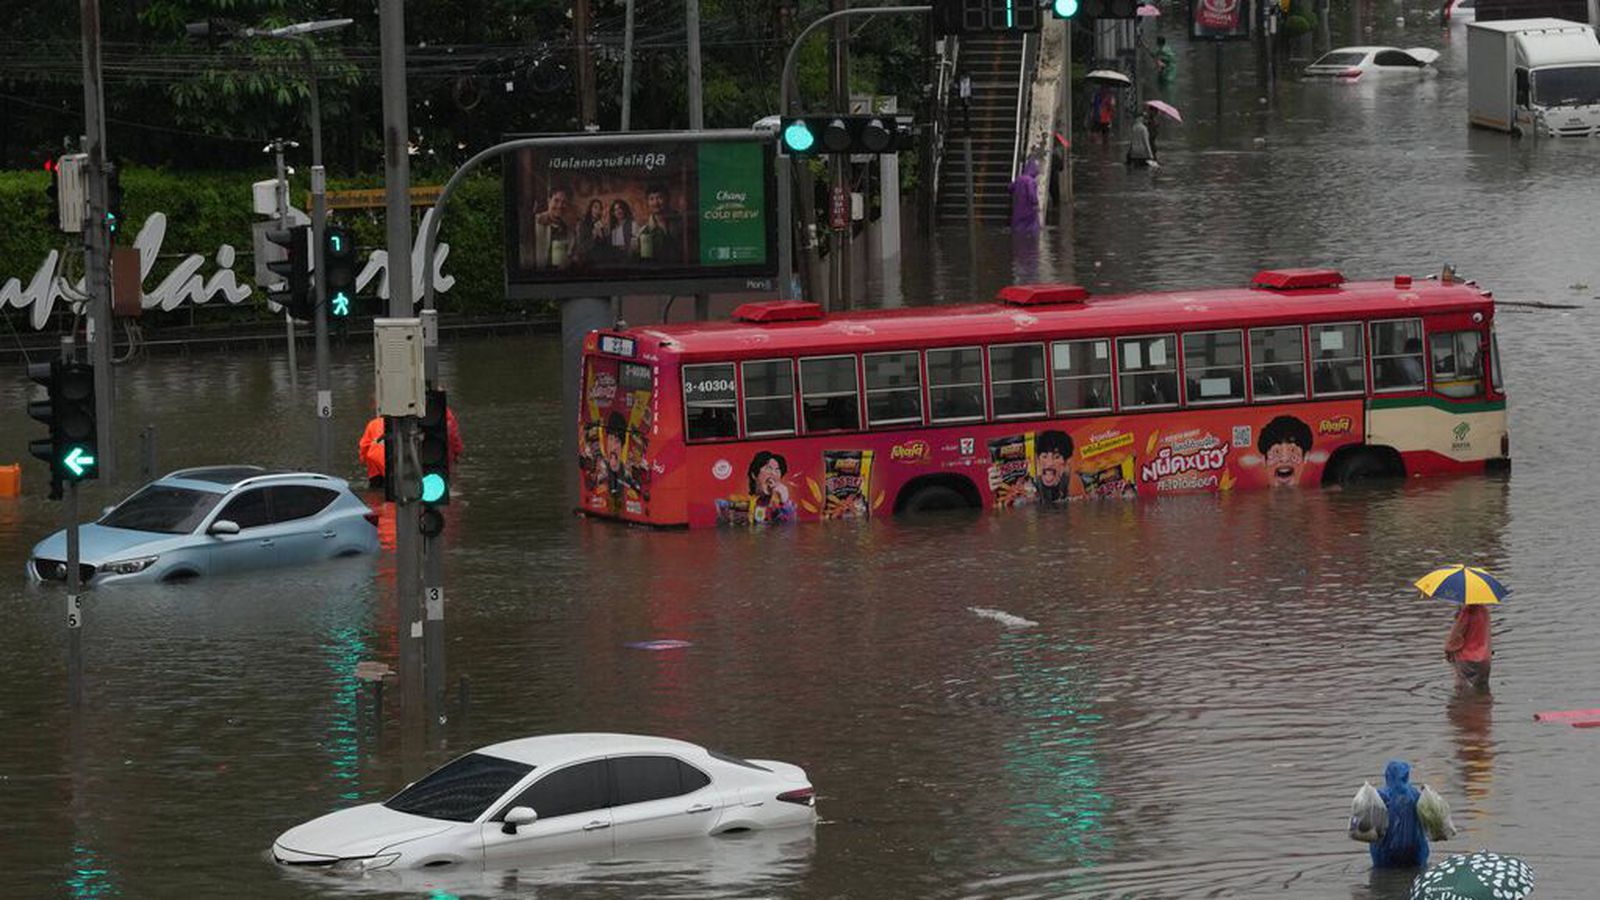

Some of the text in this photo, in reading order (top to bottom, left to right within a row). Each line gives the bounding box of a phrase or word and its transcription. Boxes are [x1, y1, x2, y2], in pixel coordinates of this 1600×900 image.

[716, 190, 747, 202] Chang
[322, 406, 330, 417] 6
[430, 588, 439, 601] 3
[69, 614, 76, 626] 5
